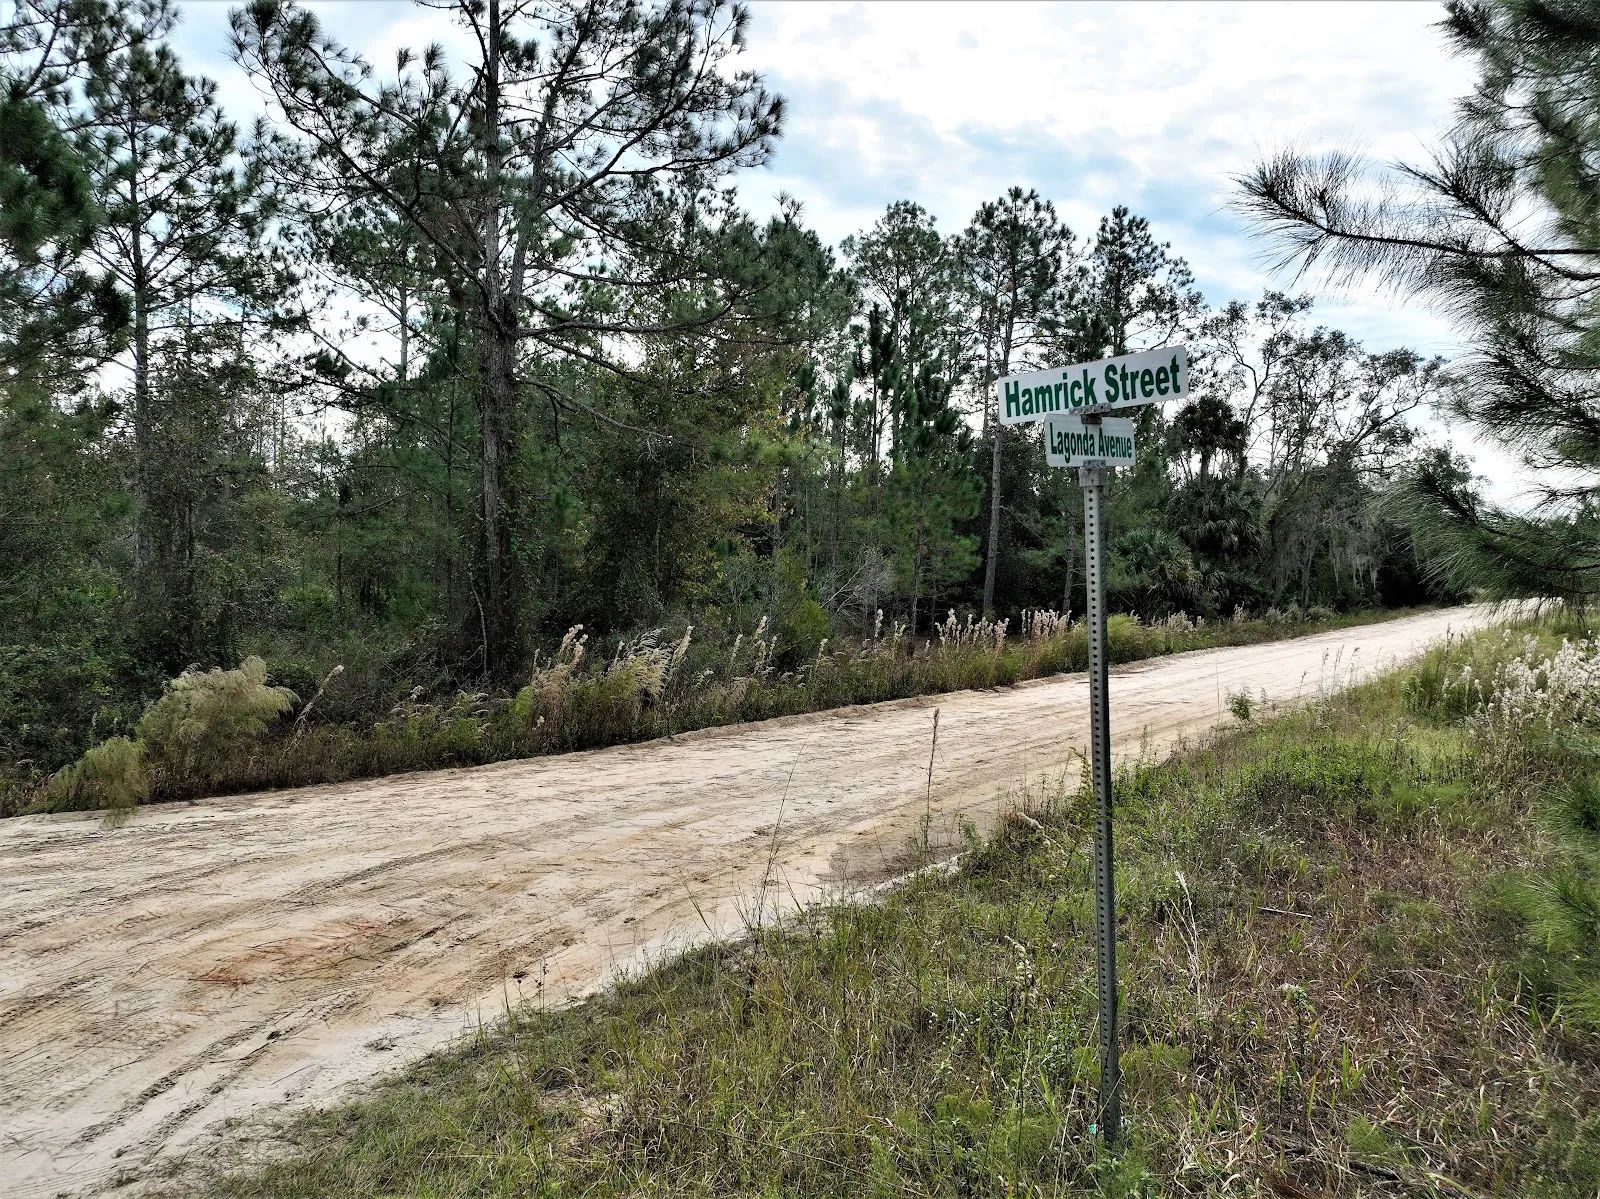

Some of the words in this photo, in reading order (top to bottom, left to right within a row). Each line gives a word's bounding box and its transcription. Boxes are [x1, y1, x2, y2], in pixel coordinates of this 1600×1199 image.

[1005, 369, 1097, 417] Hamrick
[1105, 355, 1181, 403] Street
[1050, 423, 1095, 463] Lagonda
[1099, 428, 1132, 458] Avenue
